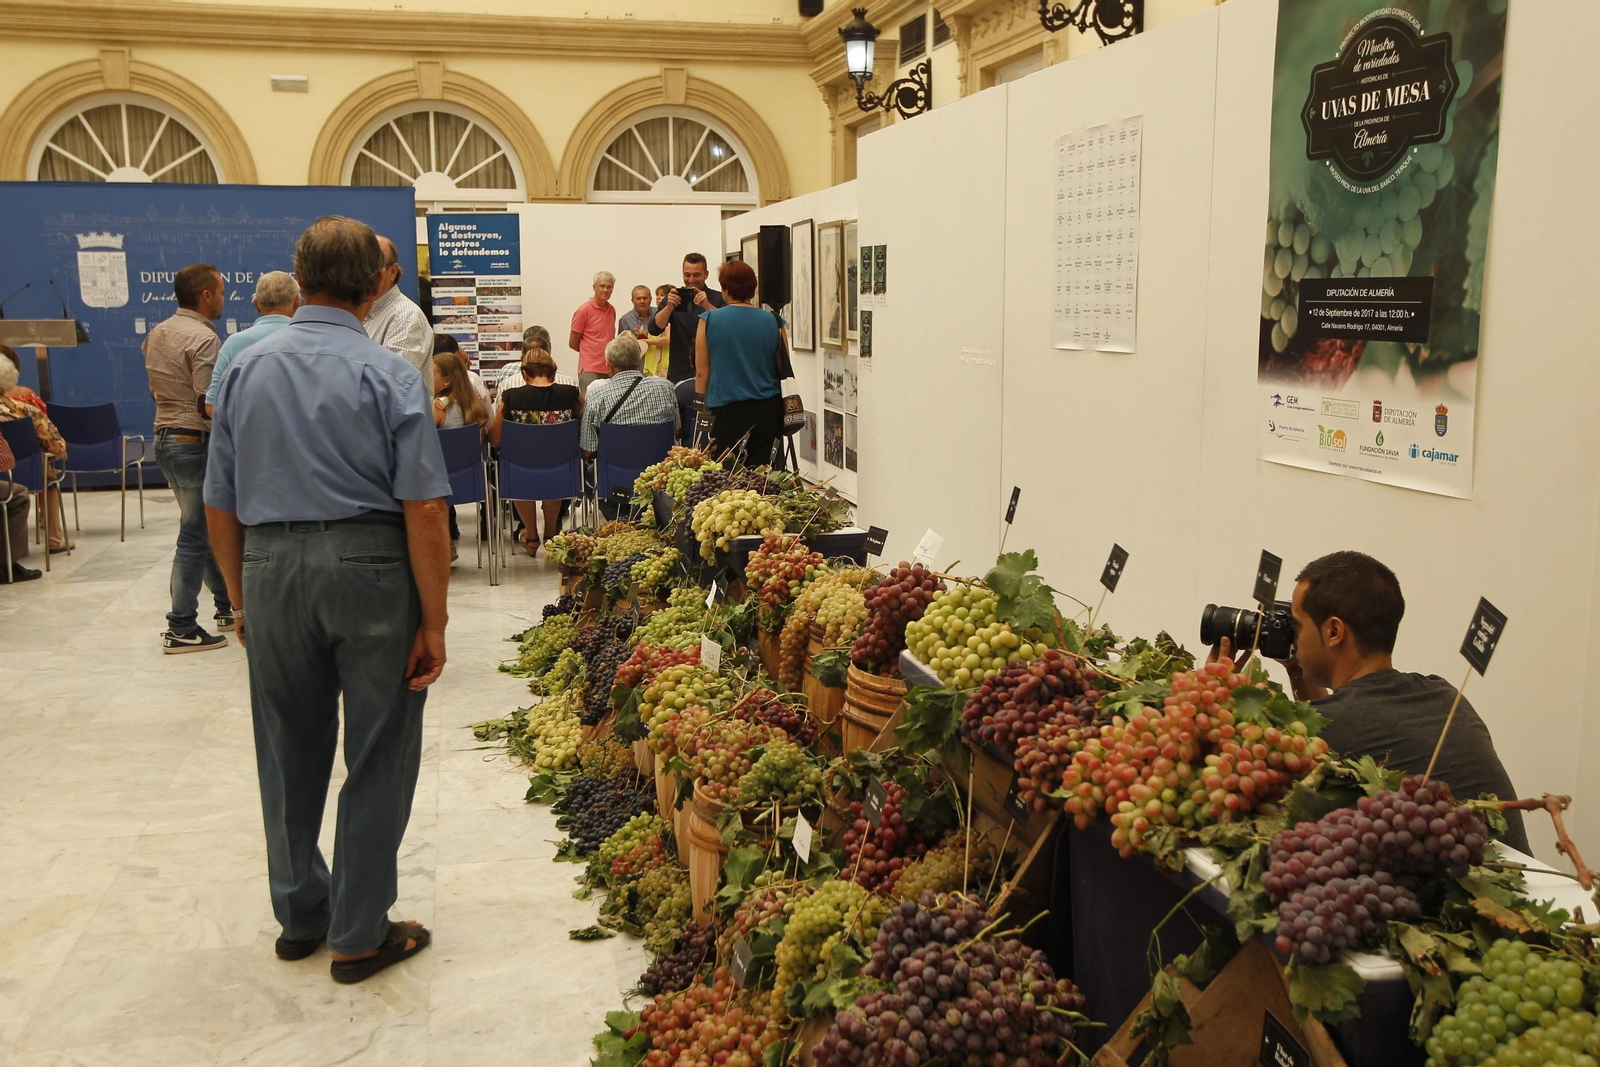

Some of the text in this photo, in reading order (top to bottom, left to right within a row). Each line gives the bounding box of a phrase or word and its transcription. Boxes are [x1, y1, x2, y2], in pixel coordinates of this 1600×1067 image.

[1340, 8, 1421, 50] PROYECTO BIODIVERSIDAD DOMESTICADA
[1358, 37, 1395, 58] Muestra
[1353, 51, 1400, 74] de variedades
[1321, 80, 1431, 120] UVAS DE MESA
[1364, 116, 1383, 126] PROVINCIA
[1354, 128, 1388, 150] Almería
[1329, 165, 1341, 183] MUSEO
[1395, 155, 1412, 176] TERQUE
[438, 223, 477, 232] Algunos
[451, 231, 502, 240] destruyen,
[452, 248, 510, 256] defendemos
[235, 272, 254, 284] DE
[230, 290, 245, 301] la
[1326, 287, 1358, 297] DIPUTACIÓN
[1368, 287, 1394, 297] ALMERÍA
[1325, 308, 1352, 318] Septiembre
[1388, 310, 1404, 318] 12:00
[1404, 310, 1410, 318] h.
[1286, 396, 1298, 404] GEM
[1384, 408, 1417, 418] DIPUTACIÓN
[1392, 417, 1415, 427] ALMERÍA
[1359, 444, 1399, 457] FUNDACIÓN SAVIA
[1422, 448, 1459, 462] cajamar
